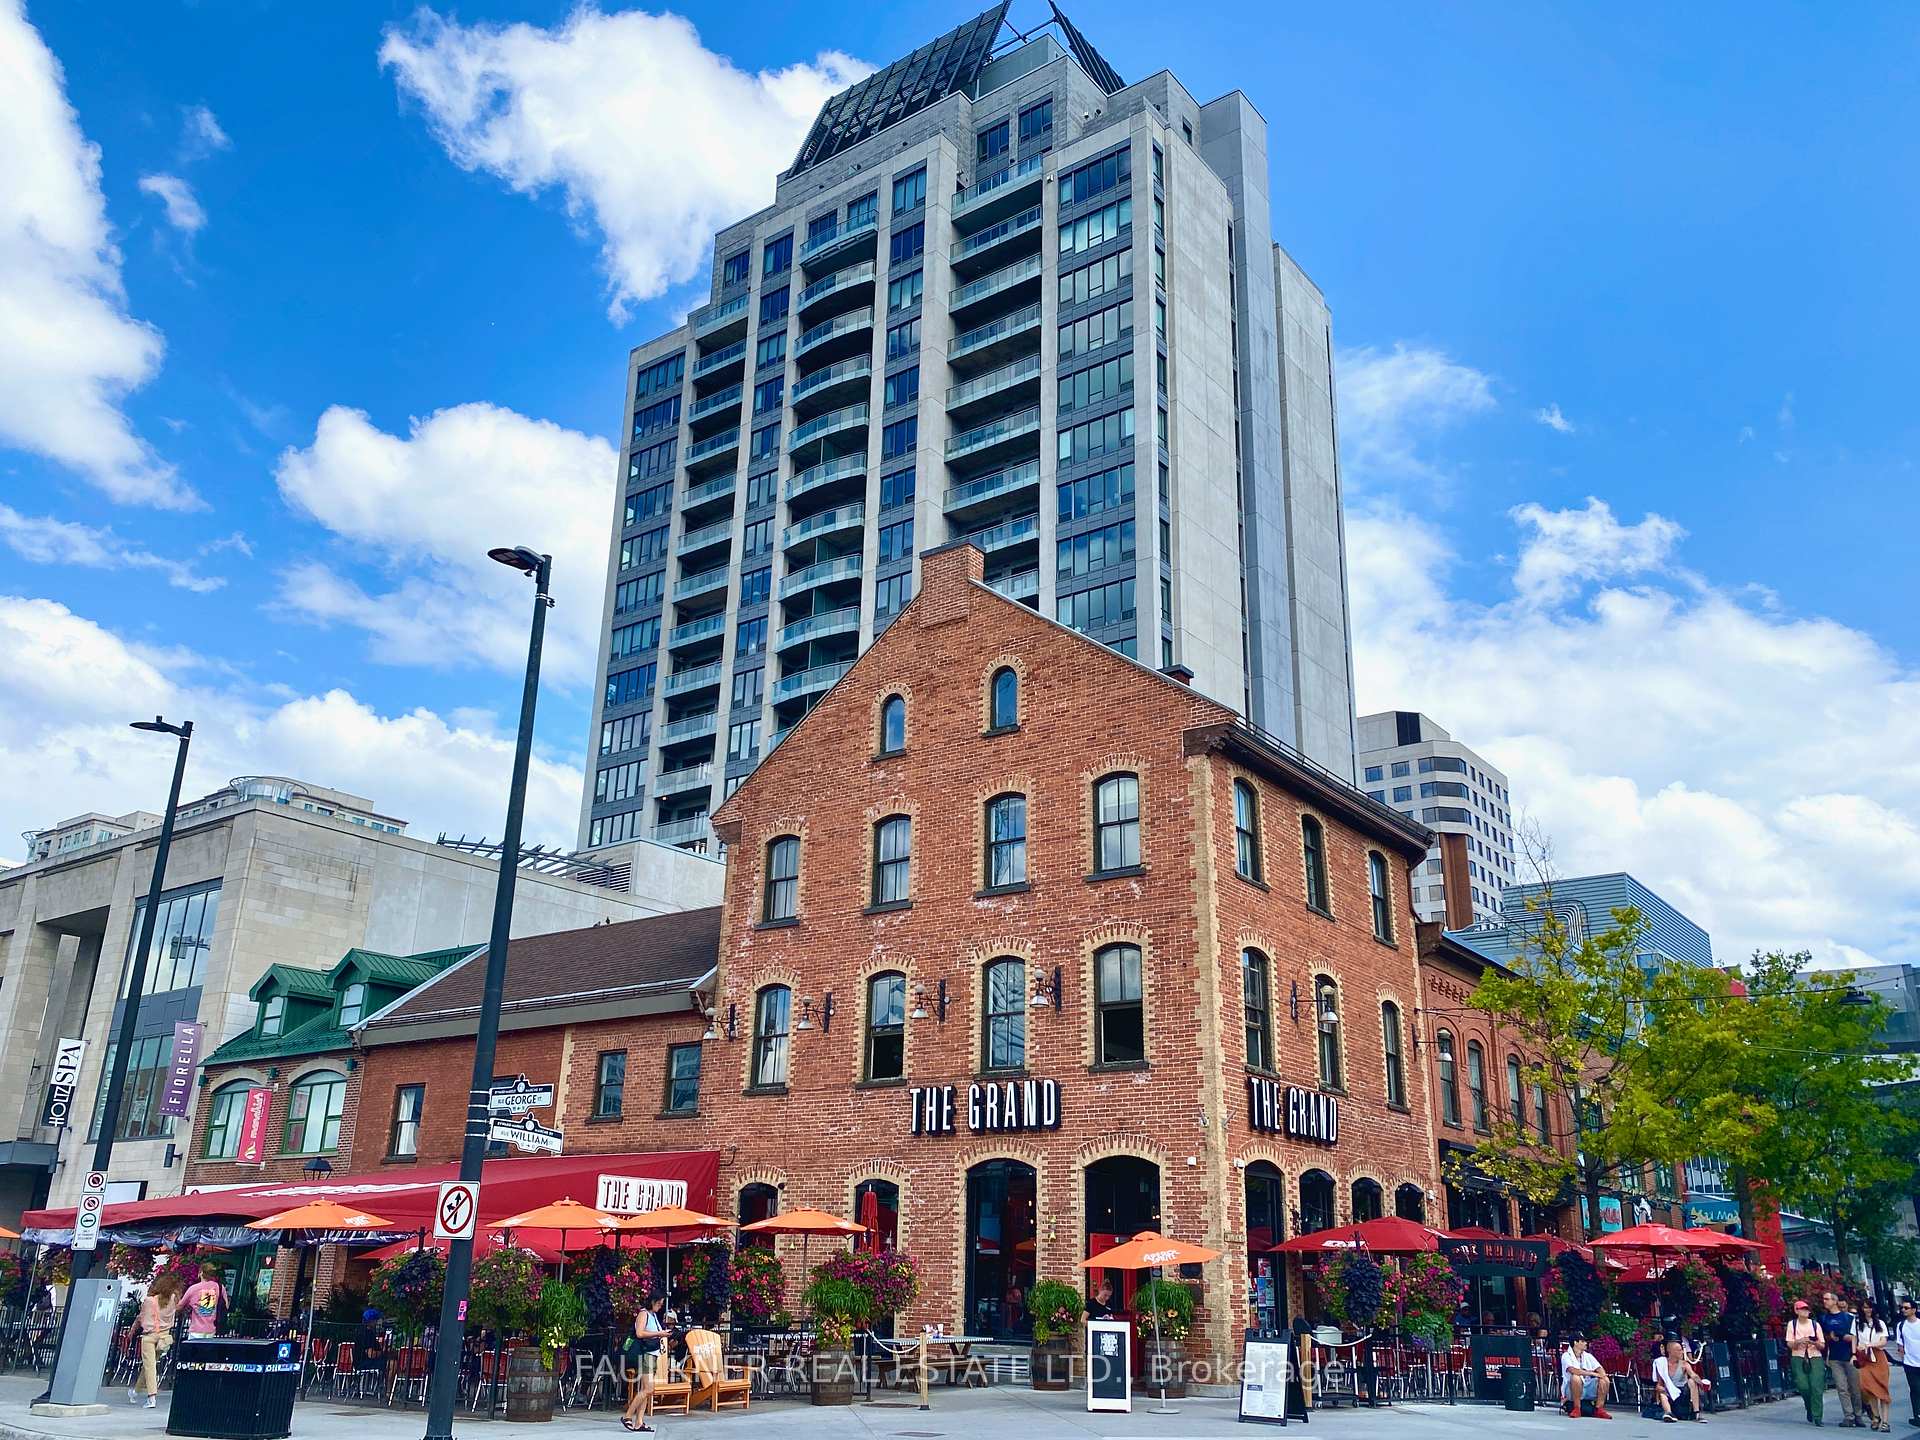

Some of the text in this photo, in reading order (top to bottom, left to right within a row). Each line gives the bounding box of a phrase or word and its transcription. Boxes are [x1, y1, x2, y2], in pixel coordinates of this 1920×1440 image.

[54, 1045, 81, 1085] SPA
[168, 1027, 195, 1105] FIORELLA
[504, 1094, 537, 1106] GEORGE
[909, 1078, 1060, 1134] THE GRAND
[1250, 1076, 1338, 1143] THE GRAND
[510, 1130, 549, 1146] WILLIAM
[602, 1179, 684, 1212] THE GRAND
